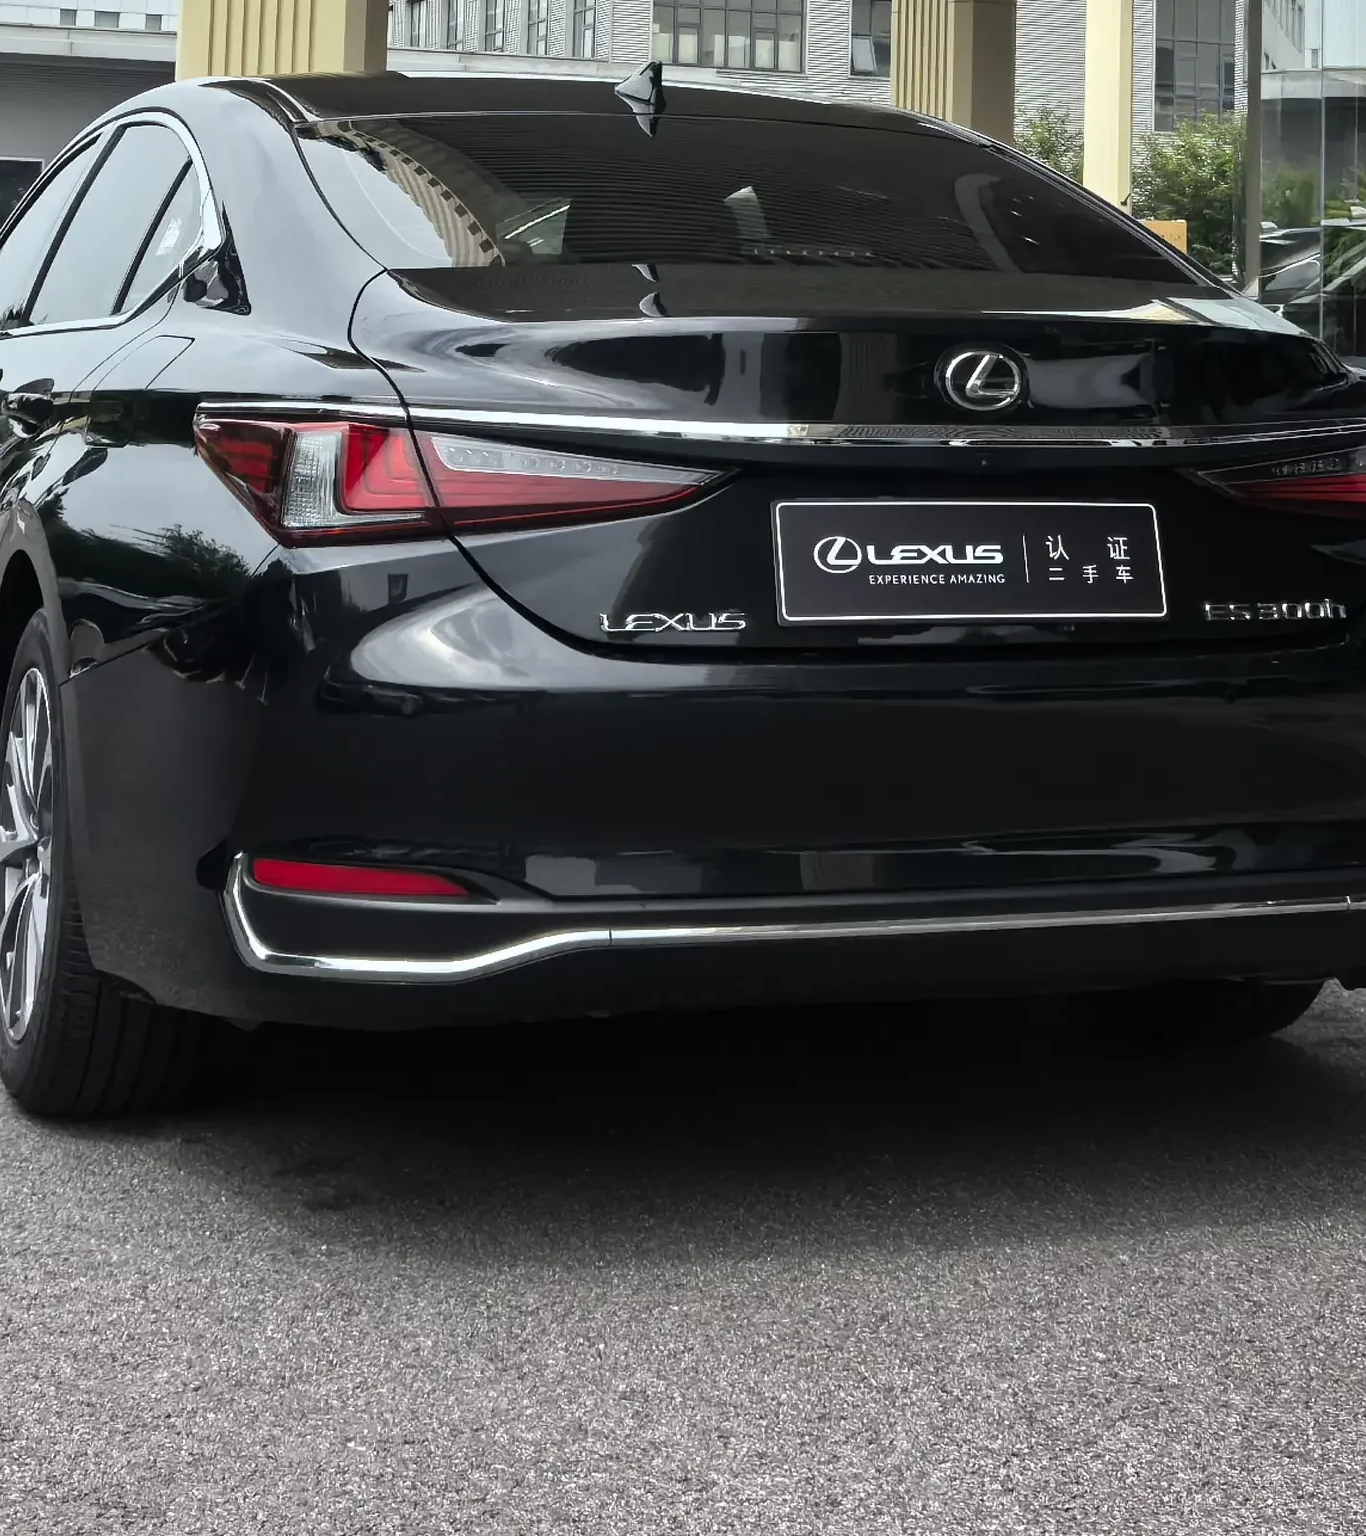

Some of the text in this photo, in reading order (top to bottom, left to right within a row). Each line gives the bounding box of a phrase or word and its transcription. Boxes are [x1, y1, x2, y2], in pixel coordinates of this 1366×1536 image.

[867, 544, 1005, 565] LEXUS
[1046, 535, 1132, 562] 认证
[869, 574, 1006, 585] EXPERIENCE AMAZING
[1048, 565, 1134, 584] 二手车
[1204, 602, 1251, 621] ES
[599, 612, 747, 632] LEXUS
